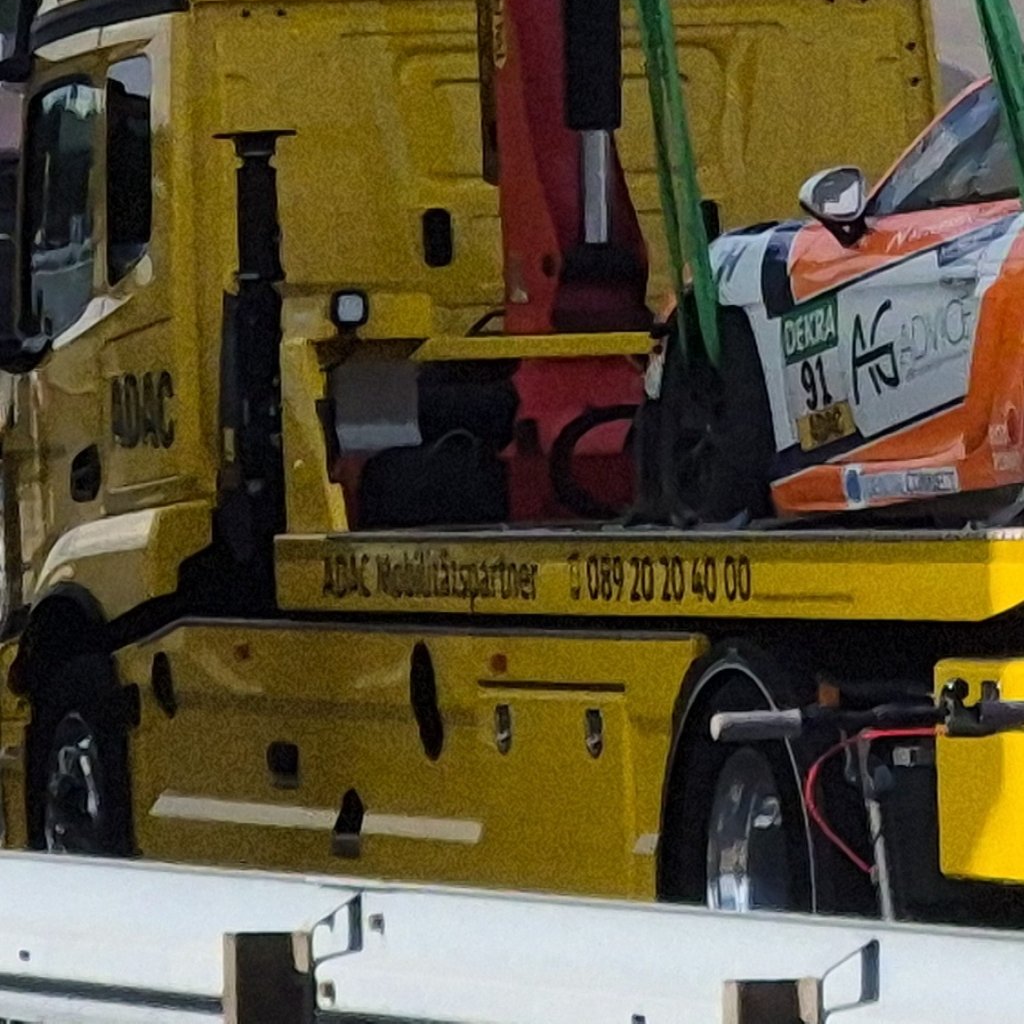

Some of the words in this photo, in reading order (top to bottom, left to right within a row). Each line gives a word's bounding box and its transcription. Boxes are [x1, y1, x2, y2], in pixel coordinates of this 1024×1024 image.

[784, 303, 836, 353] DEKRA
[801, 355, 834, 411] 91
[587, 554, 624, 603] 089
[630, 554, 654, 603] 20
[660, 554, 685, 604] 20
[692, 554, 717, 603] 40
[724, 553, 751, 603] 00
